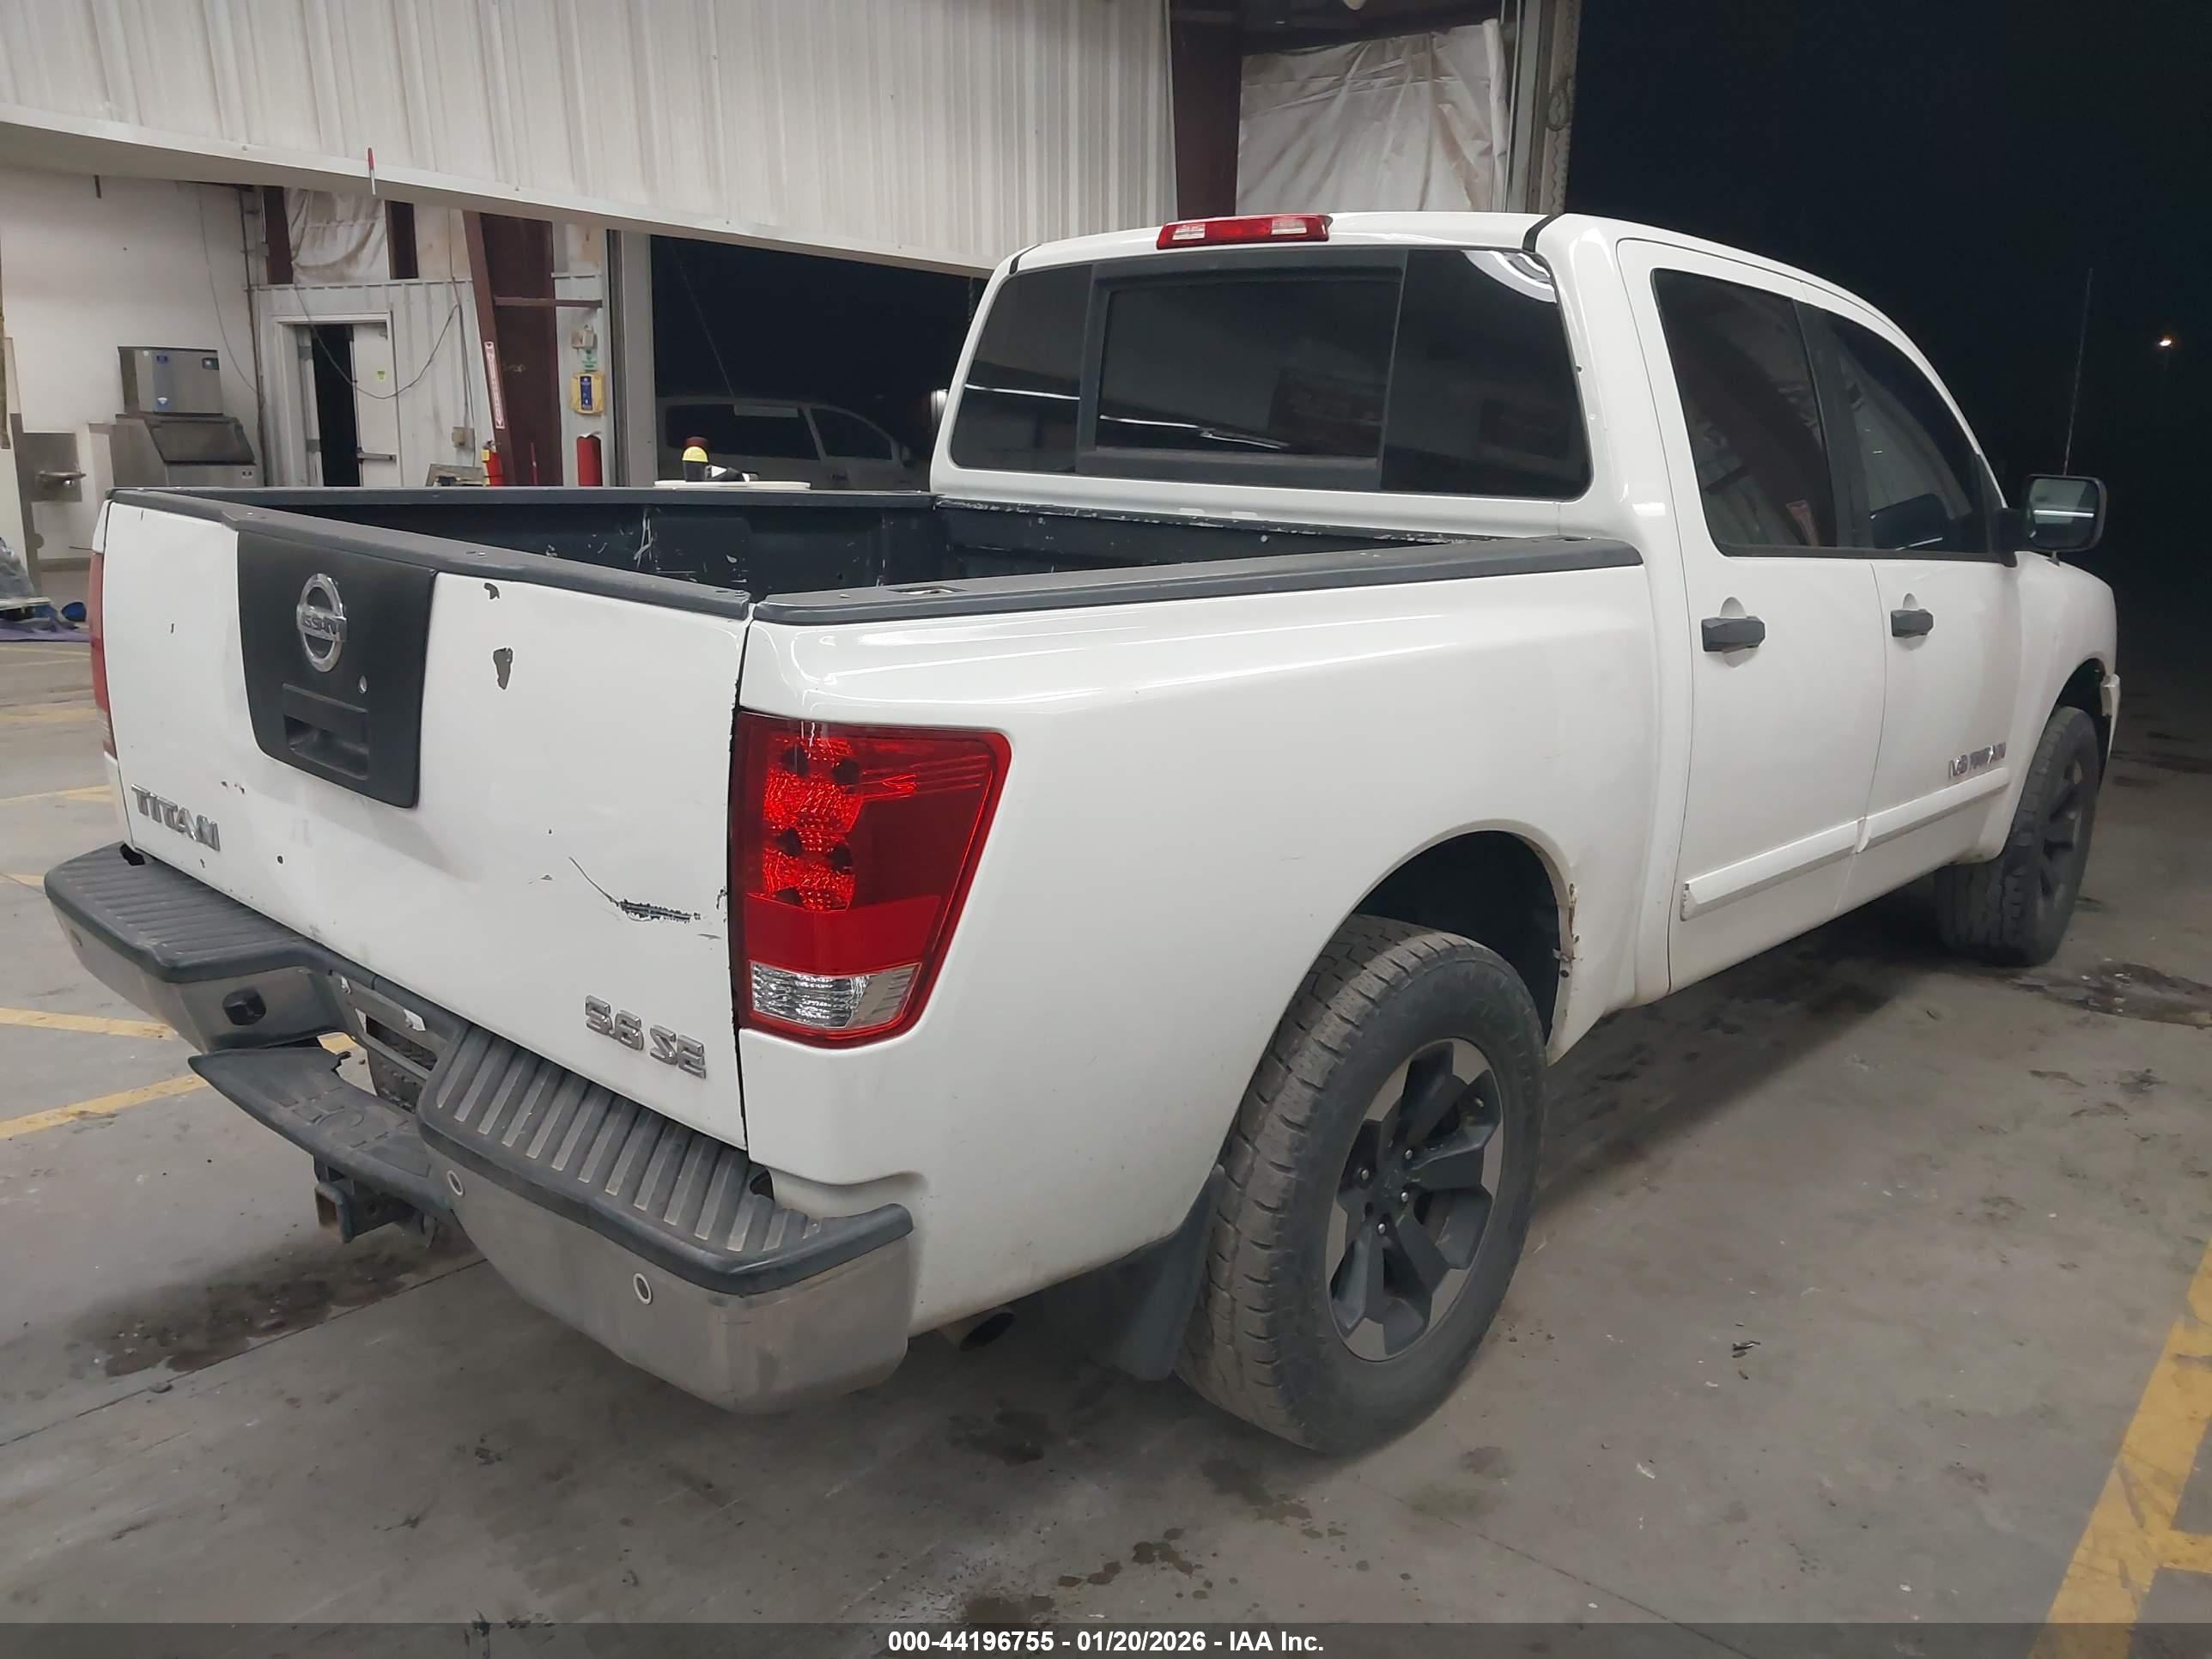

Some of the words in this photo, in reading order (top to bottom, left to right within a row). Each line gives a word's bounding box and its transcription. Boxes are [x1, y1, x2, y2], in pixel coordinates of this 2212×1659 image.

[131, 783, 221, 852] TITAN
[585, 994, 645, 1051] 5.6
[649, 1024, 707, 1079] SE
